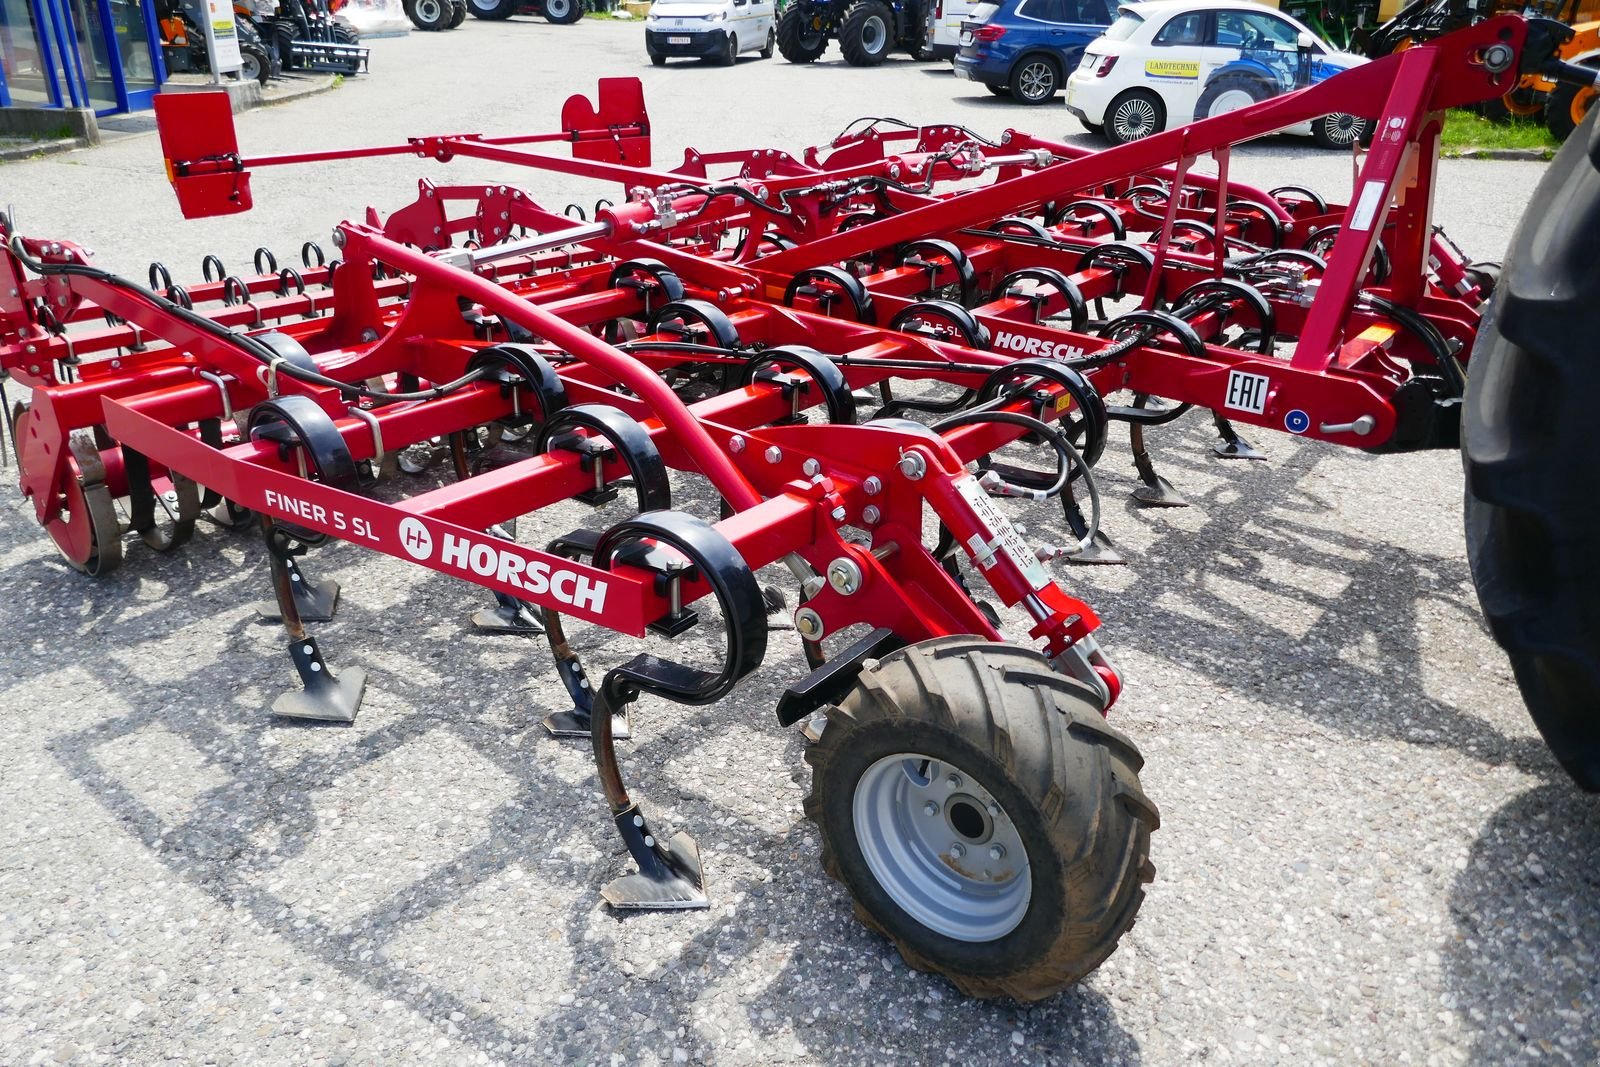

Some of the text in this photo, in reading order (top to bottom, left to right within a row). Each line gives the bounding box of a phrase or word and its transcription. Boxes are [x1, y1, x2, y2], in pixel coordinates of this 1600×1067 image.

[1150, 62, 1198, 71] LANDTECHNIK
[946, 326, 962, 338] SL
[994, 331, 1084, 360] HORSCH
[1228, 374, 1265, 410] EAC
[264, 489, 380, 542] FINER 5 SL
[441, 533, 608, 614] HORSCH
